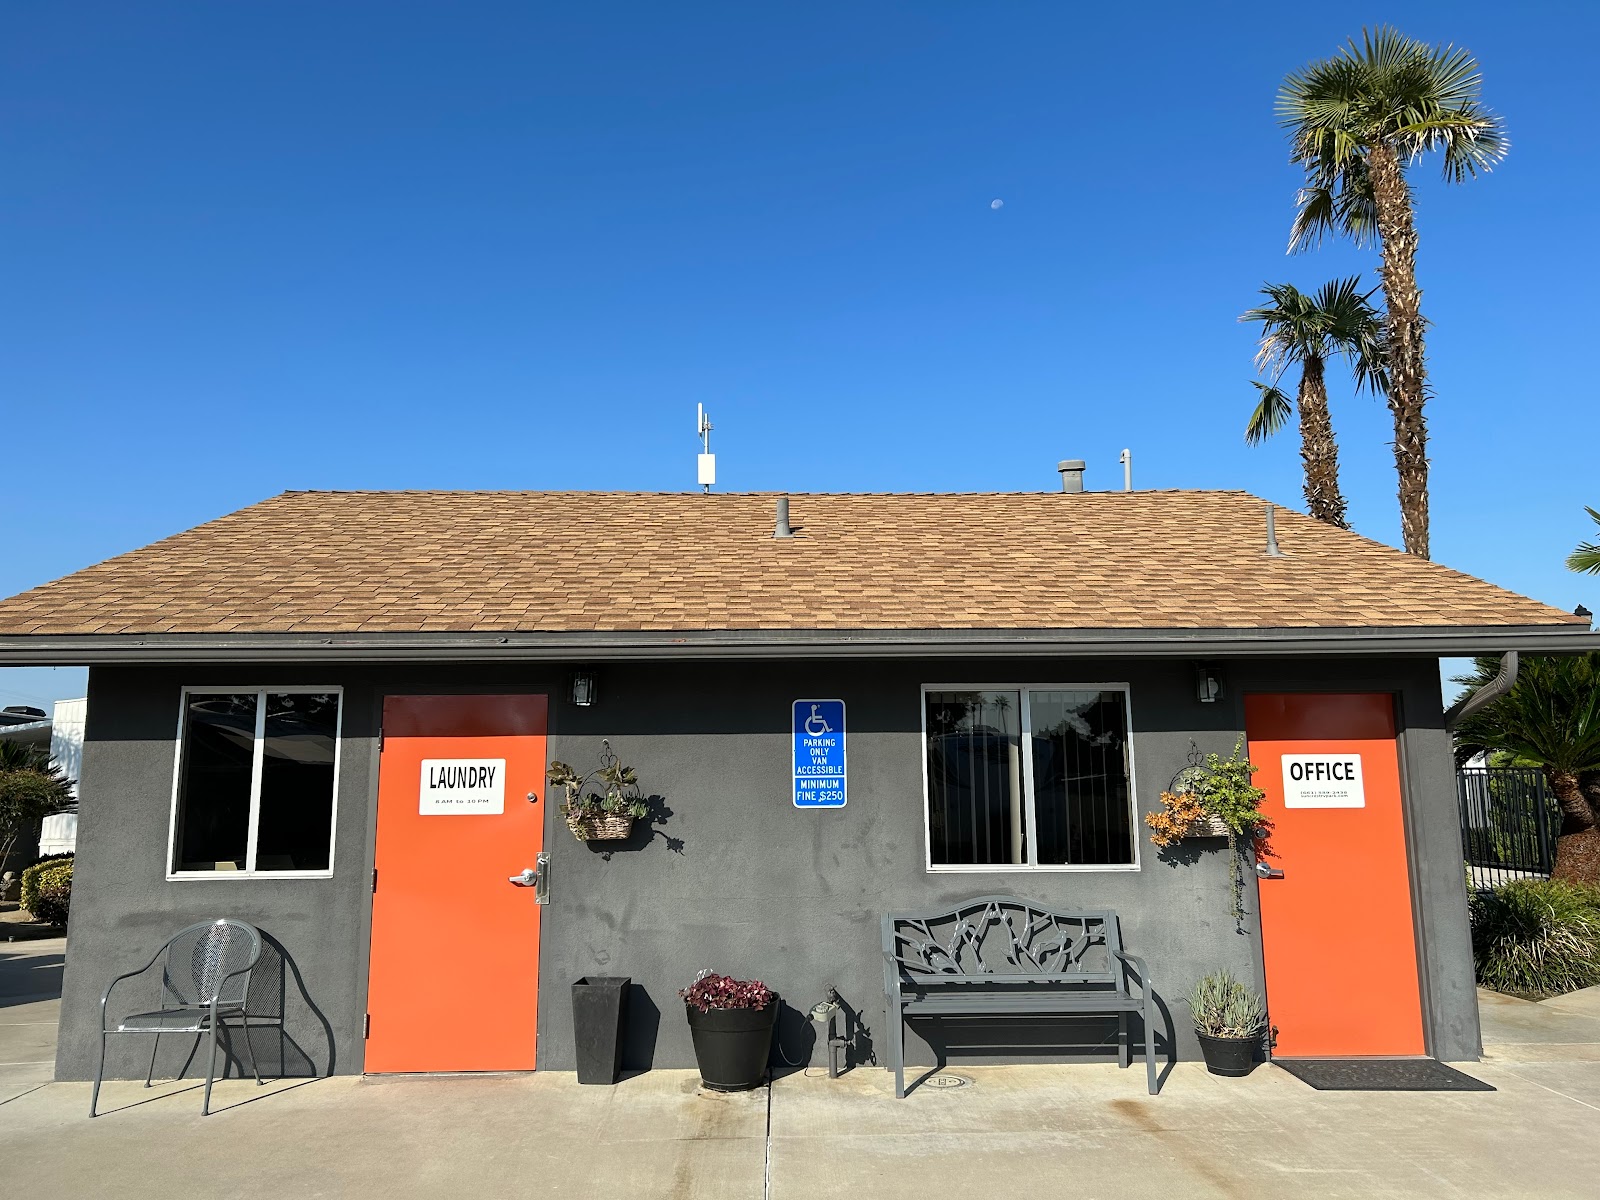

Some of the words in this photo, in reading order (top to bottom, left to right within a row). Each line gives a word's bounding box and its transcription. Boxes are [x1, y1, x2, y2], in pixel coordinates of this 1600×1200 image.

[803, 738, 836, 747] PARKING
[809, 747, 830, 756] ONLY
[811, 756, 828, 765] VAN
[796, 765, 843, 775] ACCESSIBLE
[1290, 762, 1355, 781] OFFICE
[429, 766, 496, 789] LAUNDRY
[800, 779, 840, 790] MINIMUM
[796, 791, 817, 801] FINE
[819, 790, 844, 801] $250
